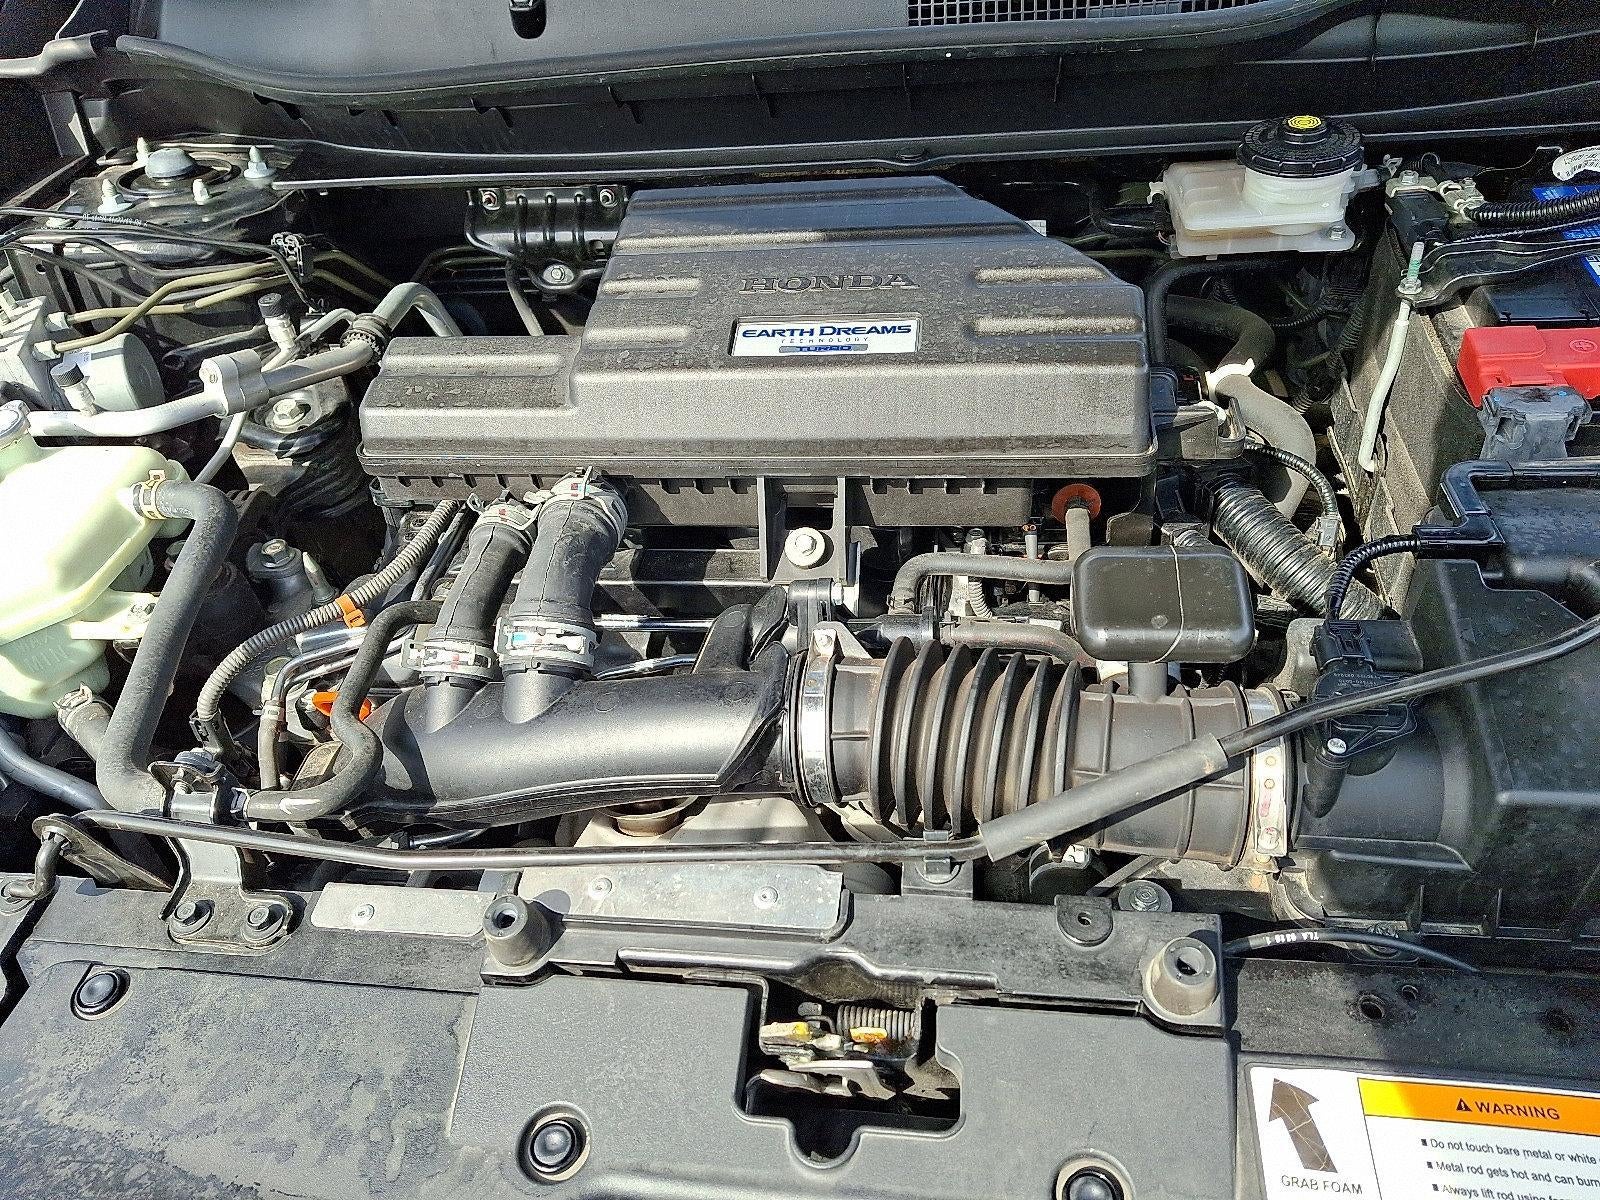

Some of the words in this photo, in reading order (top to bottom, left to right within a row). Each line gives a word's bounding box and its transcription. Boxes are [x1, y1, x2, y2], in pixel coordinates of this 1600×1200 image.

[739, 273, 921, 295] HONDA
[742, 328, 814, 338] EARTH
[818, 325, 912, 336] DREAMS
[781, 336, 869, 344] TECHNOLOGY
[1475, 1101, 1560, 1120] WARNING
[1430, 1138, 1445, 1149] Do
[1447, 1140, 1463, 1151] not
[1465, 1141, 1494, 1154] touch
[1495, 1143, 1520, 1156] bare
[1523, 1147, 1552, 1160] metal
[1554, 1152, 1566, 1161] or
[1567, 1153, 1597, 1164] white
[1436, 1161, 1464, 1173] Metal
[1466, 1164, 1484, 1175] rod
[1486, 1167, 1510, 1178] gets
[1511, 1168, 1530, 1180] hot
[1531, 1172, 1552, 1182] and
[1554, 1175, 1575, 1185] can
[1281, 1174, 1319, 1191] GRAB
[1323, 1180, 1363, 1195] FOAM
[1443, 1184, 1480, 1199] Always
[1481, 1188, 1496, 1200] lift
[1497, 1191, 1515, 1200] rod
